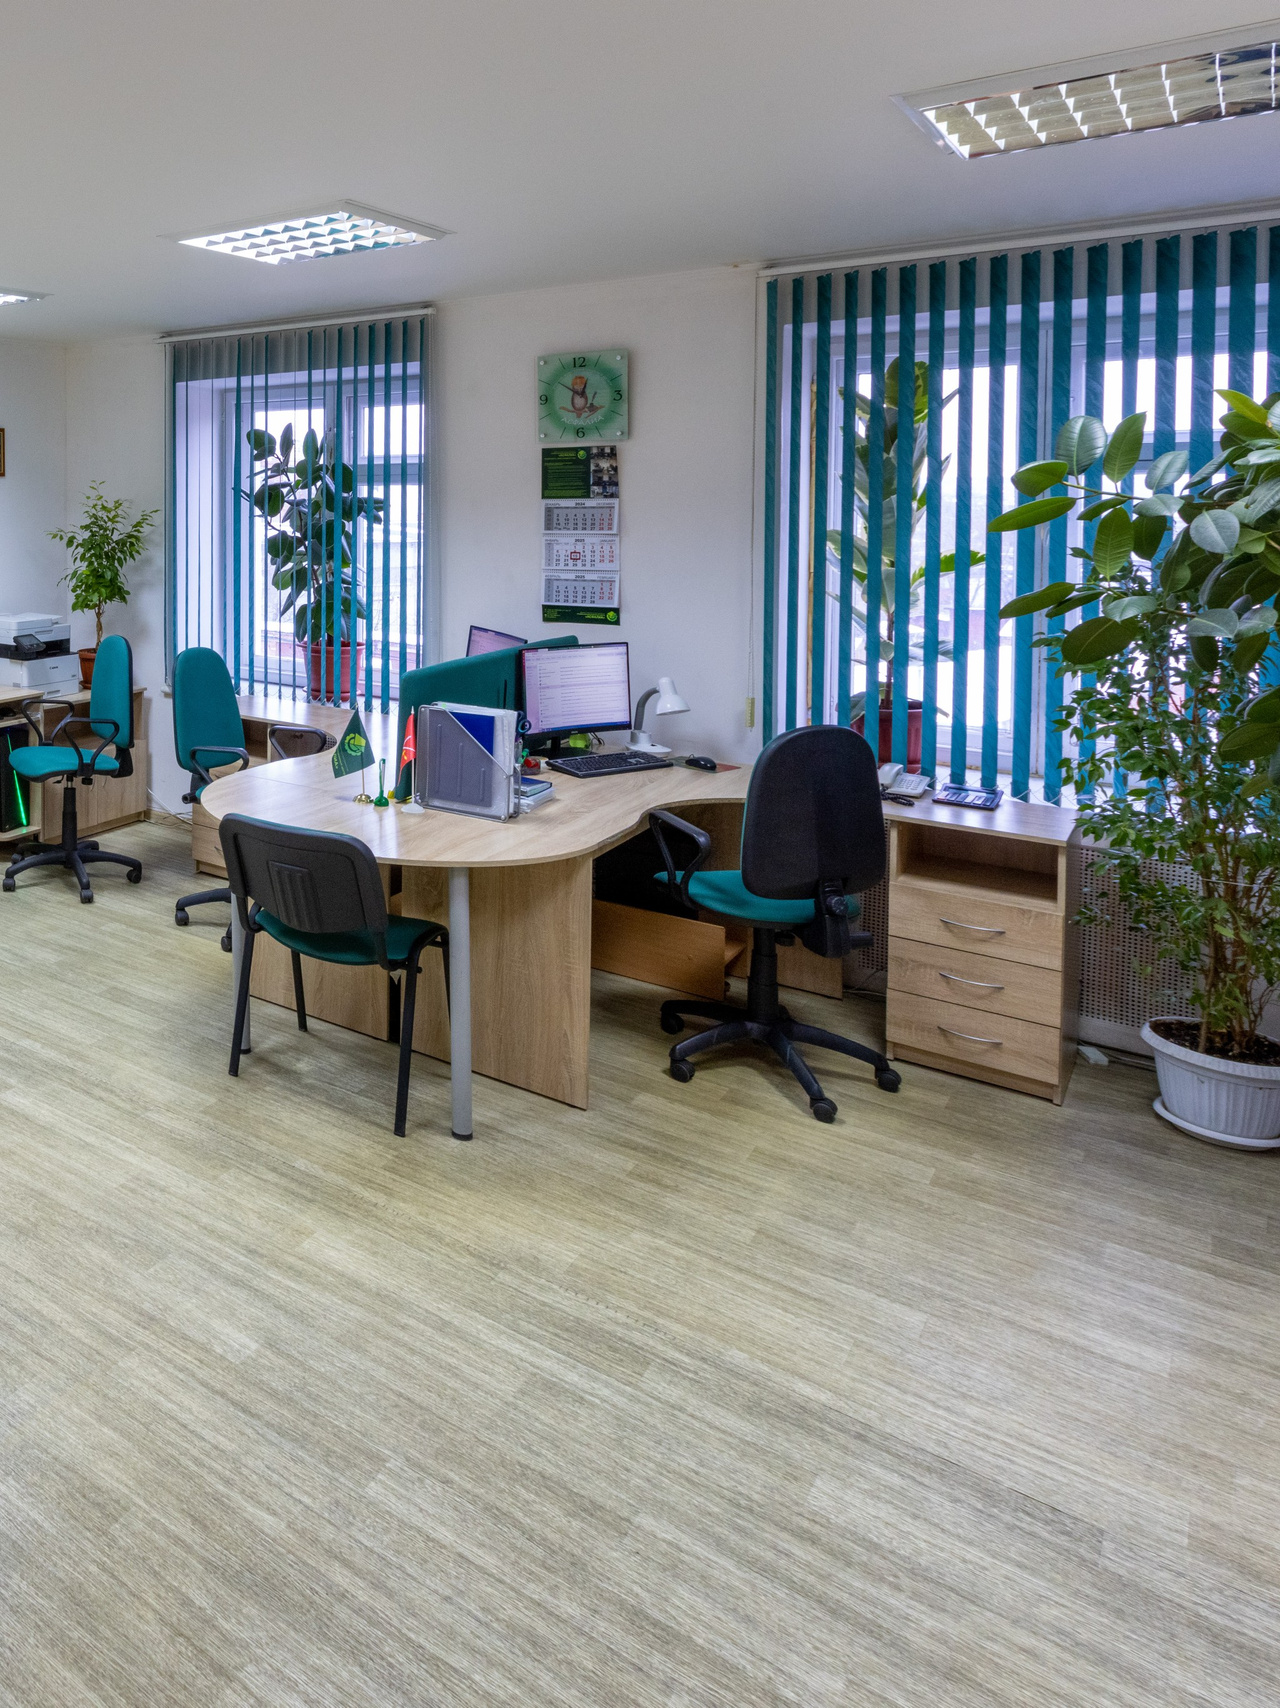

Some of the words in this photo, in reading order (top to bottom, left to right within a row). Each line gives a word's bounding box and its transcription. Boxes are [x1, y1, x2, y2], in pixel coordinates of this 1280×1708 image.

[573, 357, 586, 368] 12
[540, 394, 548, 405] 9
[613, 390, 622, 401] 3
[576, 427, 585, 438] 6
